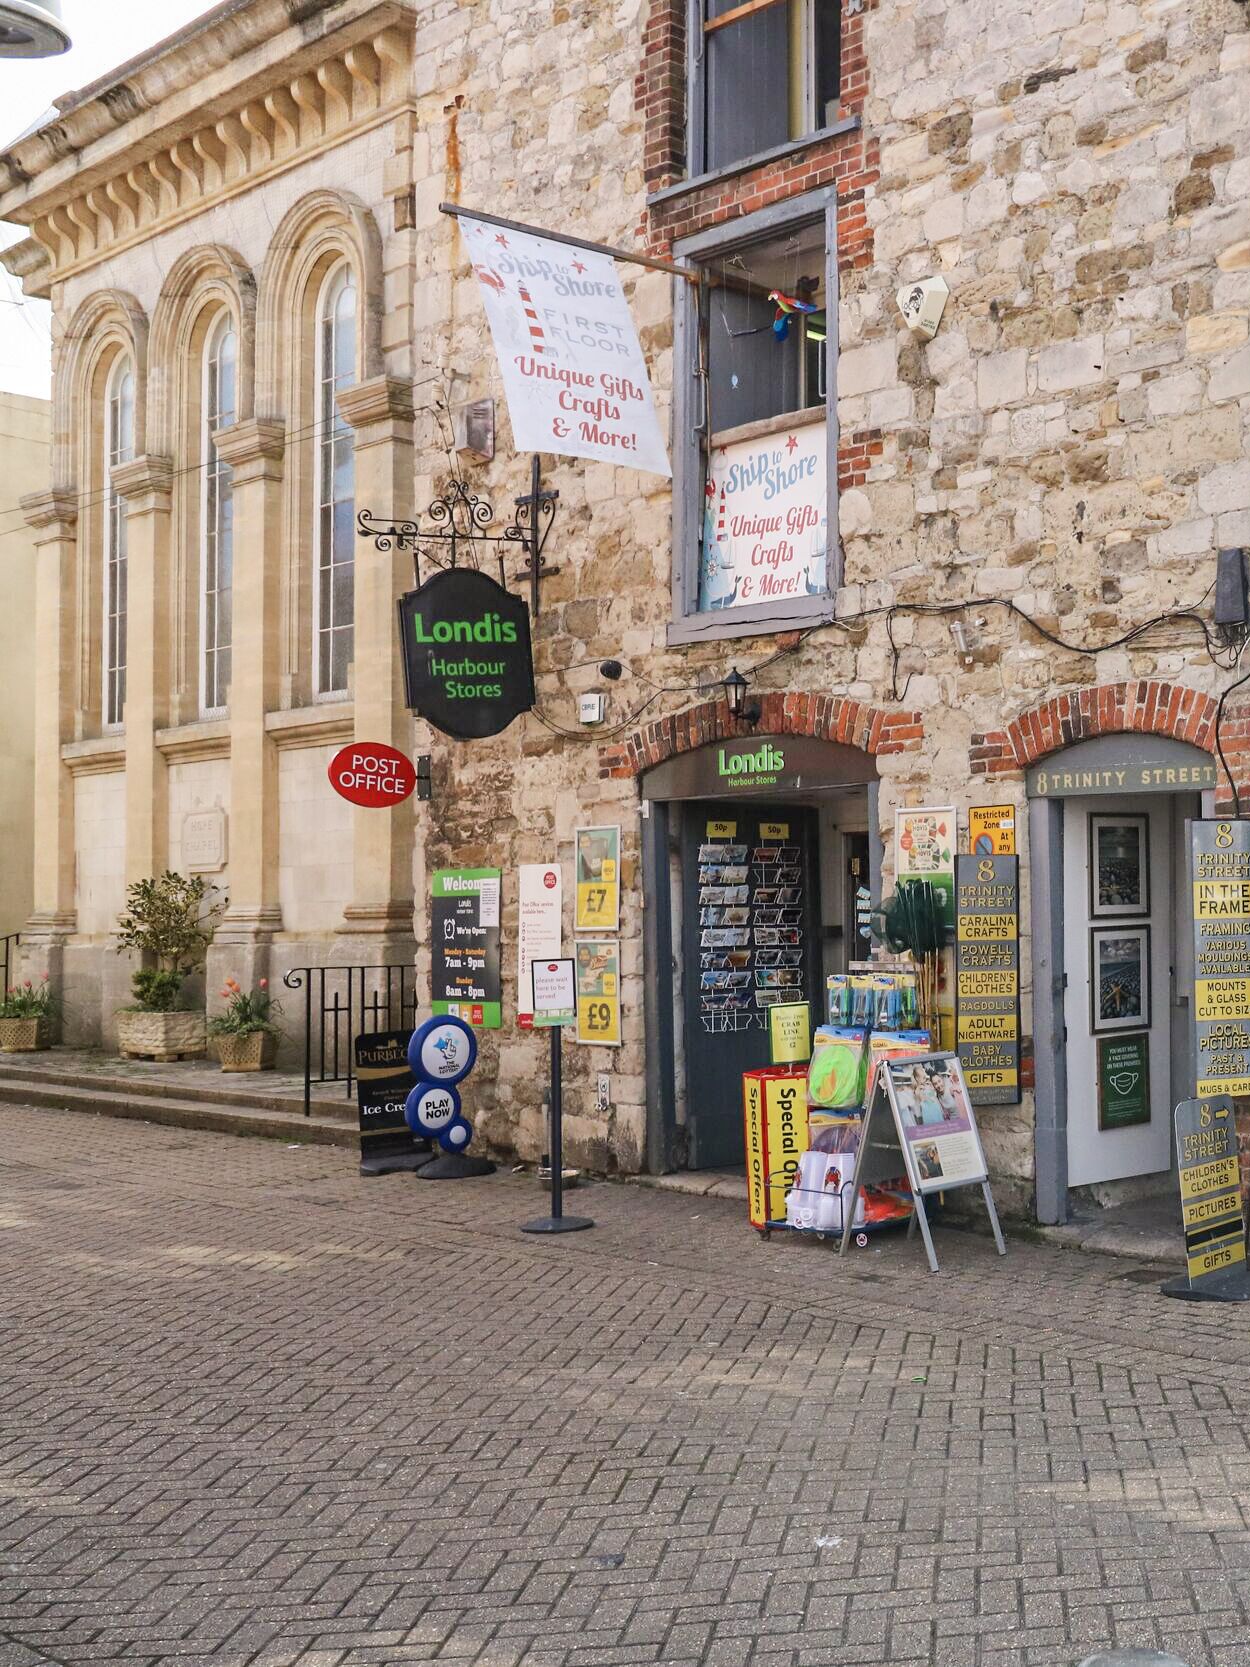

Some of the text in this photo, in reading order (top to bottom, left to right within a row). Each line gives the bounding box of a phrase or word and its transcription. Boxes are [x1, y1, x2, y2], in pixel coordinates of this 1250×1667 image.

[498, 252, 568, 280] Ship to
[552, 272, 616, 298] Shore
[543, 308, 624, 338] FIRST
[550, 327, 630, 357] FLOOR
[514, 355, 644, 402] Unique Gifts
[558, 390, 621, 422] Crafts
[552, 417, 637, 450] & More!
[726, 450, 782, 494] Ship to
[764, 454, 818, 500] Shore
[730, 504, 818, 540] Unique Gifts
[751, 540, 794, 570] Crafts
[742, 572, 801, 598] & More!
[414, 612, 517, 644] Londis
[432, 658, 506, 677] Harbour
[445, 681, 502, 698] Stores
[352, 754, 400, 775] POST
[718, 744, 785, 776] Londis
[339, 772, 406, 794] OFFICE
[728, 776, 777, 788] Harbour Stores
[1036, 766, 1214, 795] 8 TRINITY STREET
[974, 810, 1010, 820] Restricted
[714, 822, 728, 833] 50p
[768, 825, 782, 835] 50p
[984, 820, 1000, 829] Zone
[1000, 832, 1008, 840] At
[1215, 823, 1234, 848] 8
[998, 843, 1011, 852] any
[977, 859, 996, 882] 8
[442, 876, 480, 891] Welcom
[960, 886, 1014, 897] TRINITY
[1200, 884, 1250, 898] IN THE
[586, 889, 607, 912] £7
[960, 898, 1014, 908] STREET
[1200, 900, 1250, 914] FRAME
[960, 916, 1014, 927] CARALINA
[965, 928, 1008, 938] CRAFTS
[960, 944, 1012, 955] POWELL
[1206, 940, 1246, 951] VARIOUS
[445, 957, 462, 968] 7am
[468, 957, 485, 970] 9pm
[962, 956, 1012, 966] CRAFTS
[536, 977, 554, 986] please
[958, 972, 1015, 984] CHILDREN'S
[446, 985, 462, 996] 8am
[468, 985, 486, 998] 8pm
[961, 984, 1013, 994] CLOTHES
[1208, 982, 1246, 992] MOUNTS
[960, 1000, 1015, 1011] RAGDOLLS
[1208, 994, 1246, 1004] & GLASS
[588, 1003, 611, 1030] £9
[1199, 1007, 1217, 1016] CUT
[1220, 1006, 1232, 1015] TO
[968, 1018, 1006, 1029] ADULT
[958, 1030, 1015, 1040] NIGHTWARE
[1208, 1024, 1245, 1038] LOCAL
[359, 1050, 408, 1064] PURBEC
[972, 1045, 1002, 1056] BABY
[961, 1056, 1013, 1068] CLOTHES
[1210, 1054, 1244, 1064] PAST &
[1206, 1064, 1250, 1076] PRESENT
[970, 1072, 1003, 1084] GIFTS
[1200, 1084, 1222, 1094] MUGS
[1224, 1084, 1230, 1092] &
[363, 1103, 406, 1116] Ice Cre
[426, 1098, 449, 1110] PLAY
[426, 1108, 450, 1120] NOW
[777, 1088, 798, 1154] Special
[1200, 1103, 1212, 1128] 8
[1184, 1128, 1229, 1148] TRINITY
[750, 1087, 761, 1215] Special Offers
[1184, 1140, 1230, 1162] STREET
[1183, 1160, 1234, 1182] CHILDREN'S
[1191, 1174, 1229, 1193] CLOTHES
[1189, 1196, 1236, 1220] PICTURES
[1204, 1250, 1232, 1269] GIFTS
